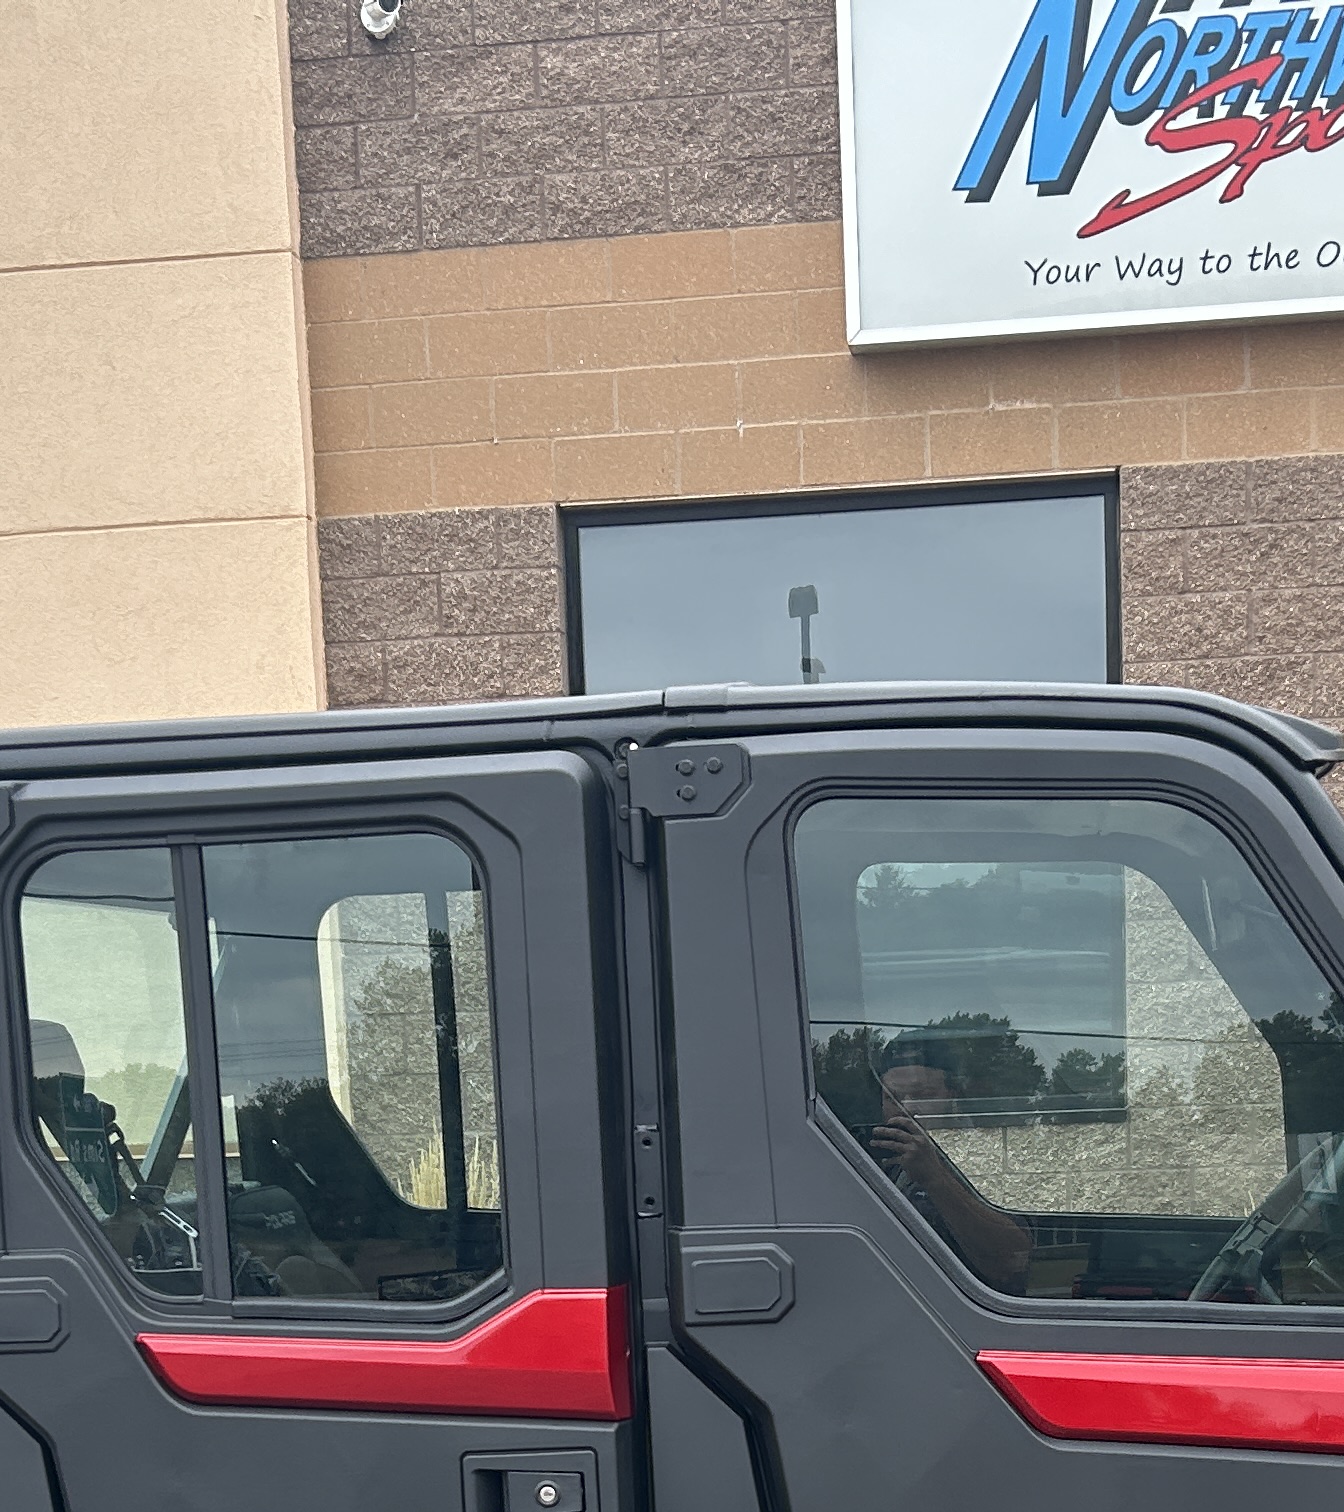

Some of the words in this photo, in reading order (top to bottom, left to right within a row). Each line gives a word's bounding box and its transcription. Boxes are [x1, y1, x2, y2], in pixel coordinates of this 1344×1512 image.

[1024, 257, 1101, 287] Your
[1114, 253, 1185, 285] Way
[1198, 247, 1233, 275] to
[1246, 242, 1301, 272] the
